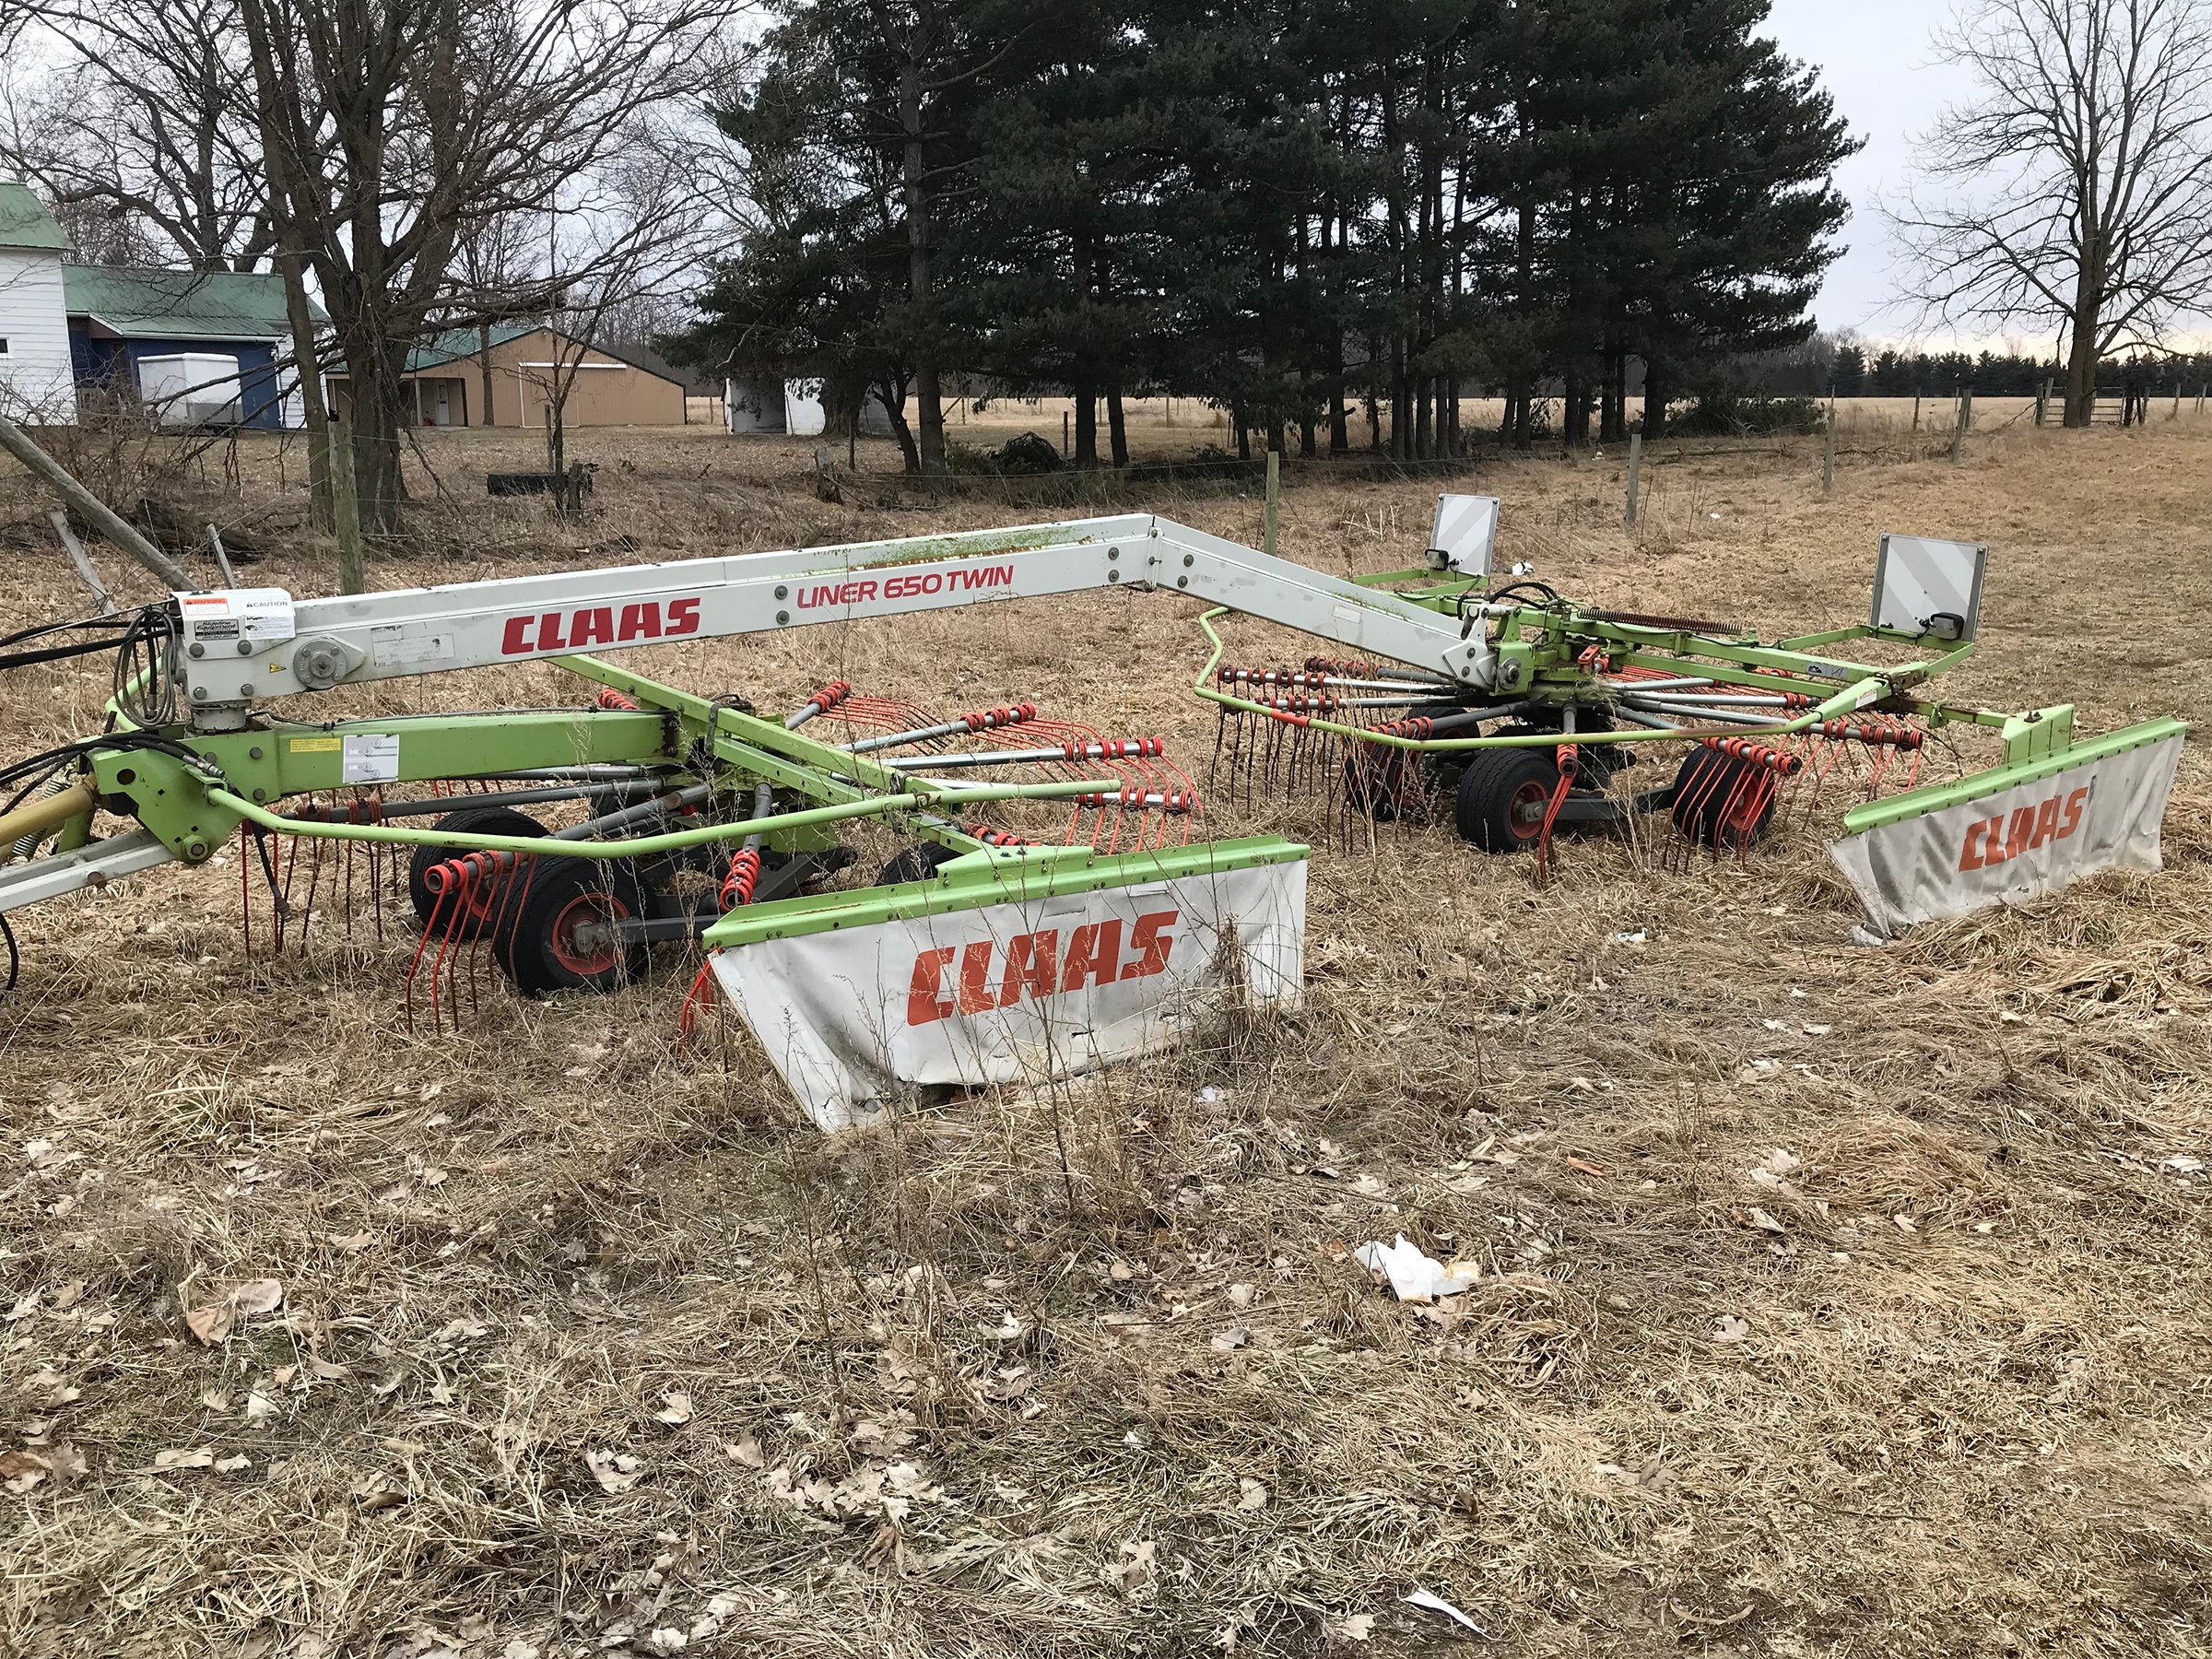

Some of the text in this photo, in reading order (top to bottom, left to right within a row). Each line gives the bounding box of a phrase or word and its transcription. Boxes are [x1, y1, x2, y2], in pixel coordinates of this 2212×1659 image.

[797, 565, 1014, 609] LINER 650 TWIN
[501, 597, 700, 655] CLAAS
[1959, 786, 2088, 872] CLAAS
[907, 910, 1180, 1027] CLAAS
